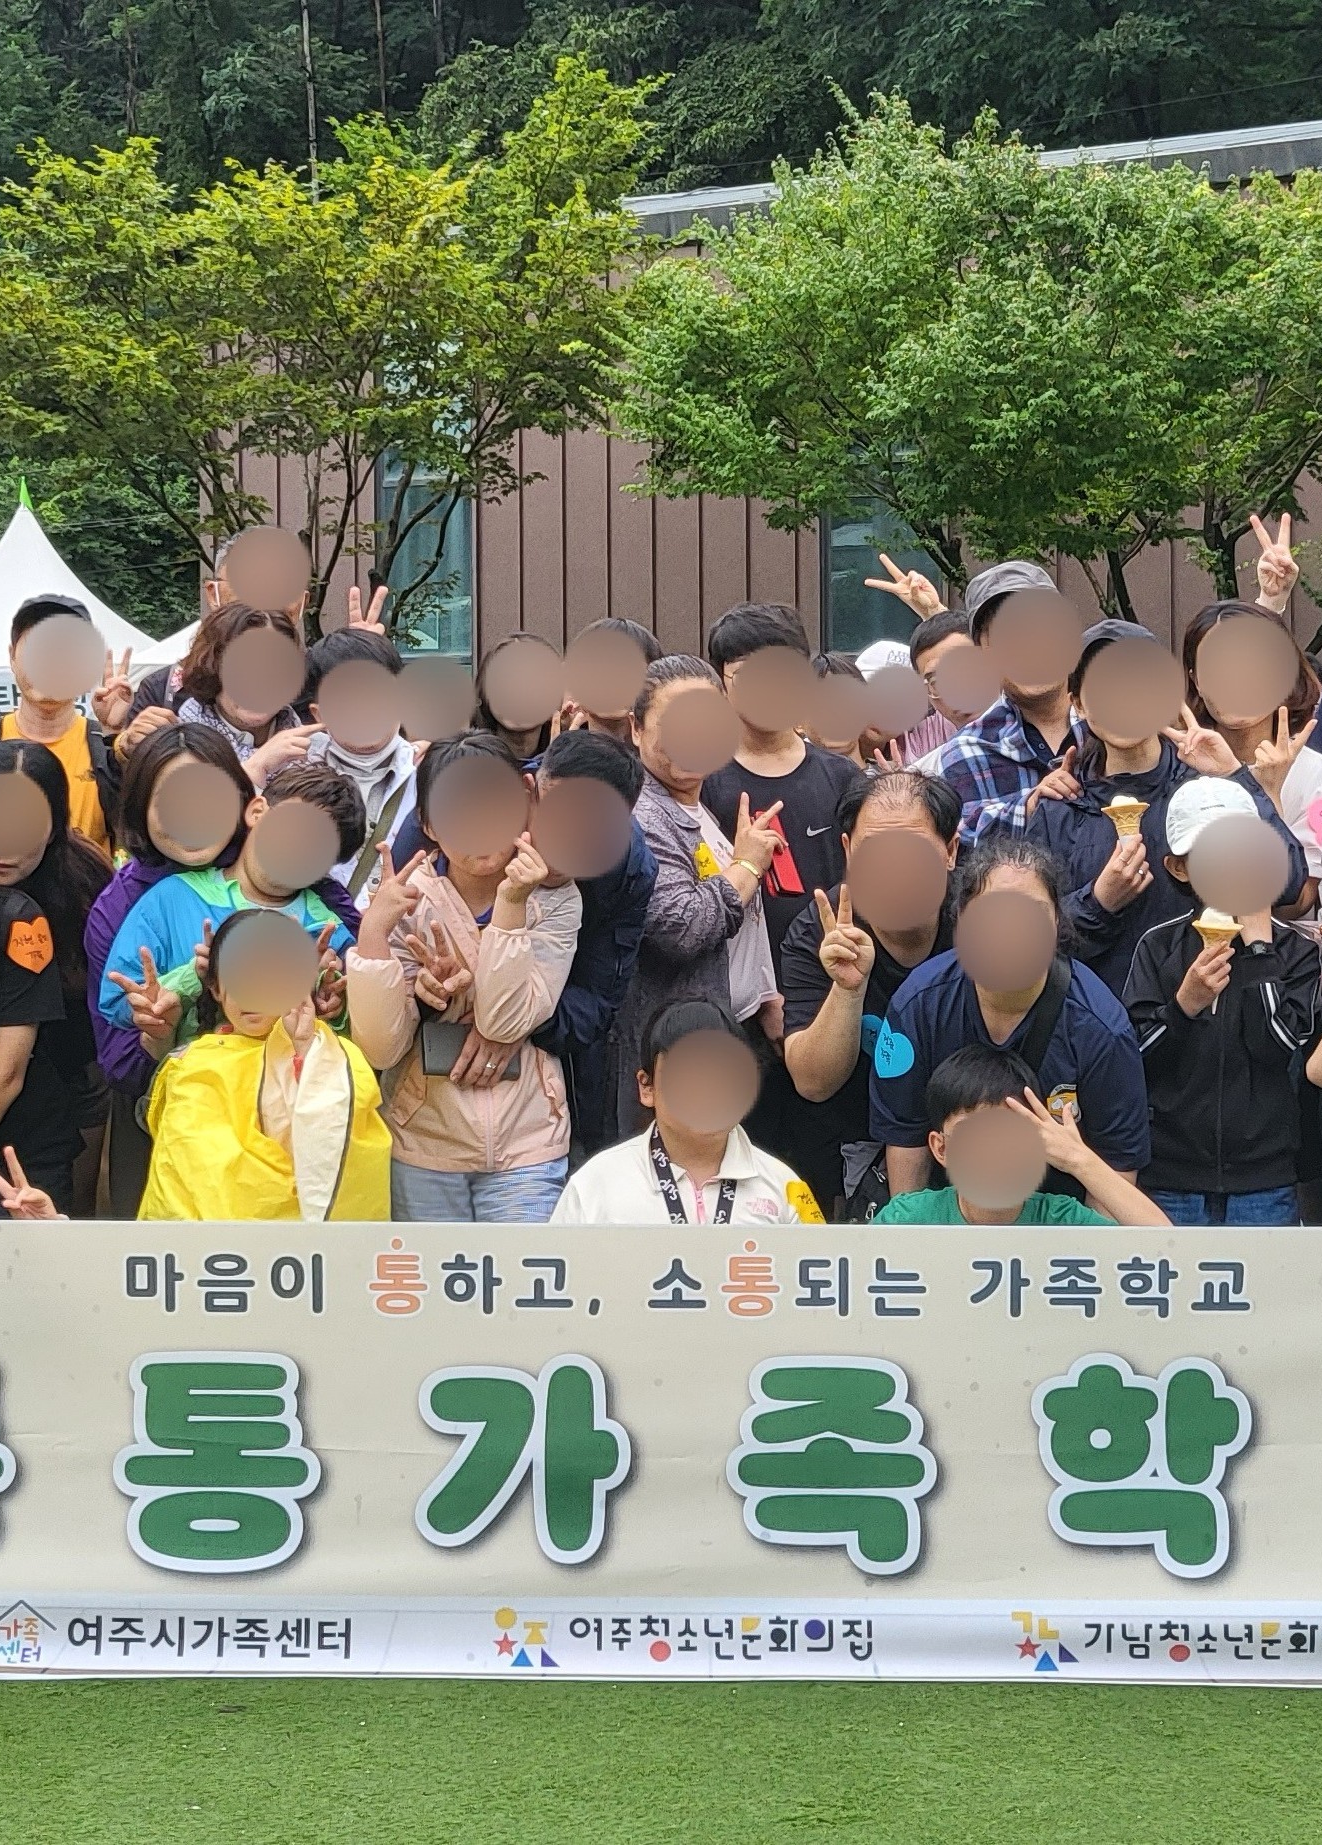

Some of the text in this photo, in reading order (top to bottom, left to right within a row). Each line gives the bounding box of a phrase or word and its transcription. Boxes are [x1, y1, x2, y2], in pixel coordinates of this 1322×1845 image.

[125, 1238, 1251, 1318] 마음이 통하고, 소통되는 가족학교
[67, 1615, 352, 1659] 여주시가족센터
[569, 1615, 873, 1662] 여주청소년문화의집
